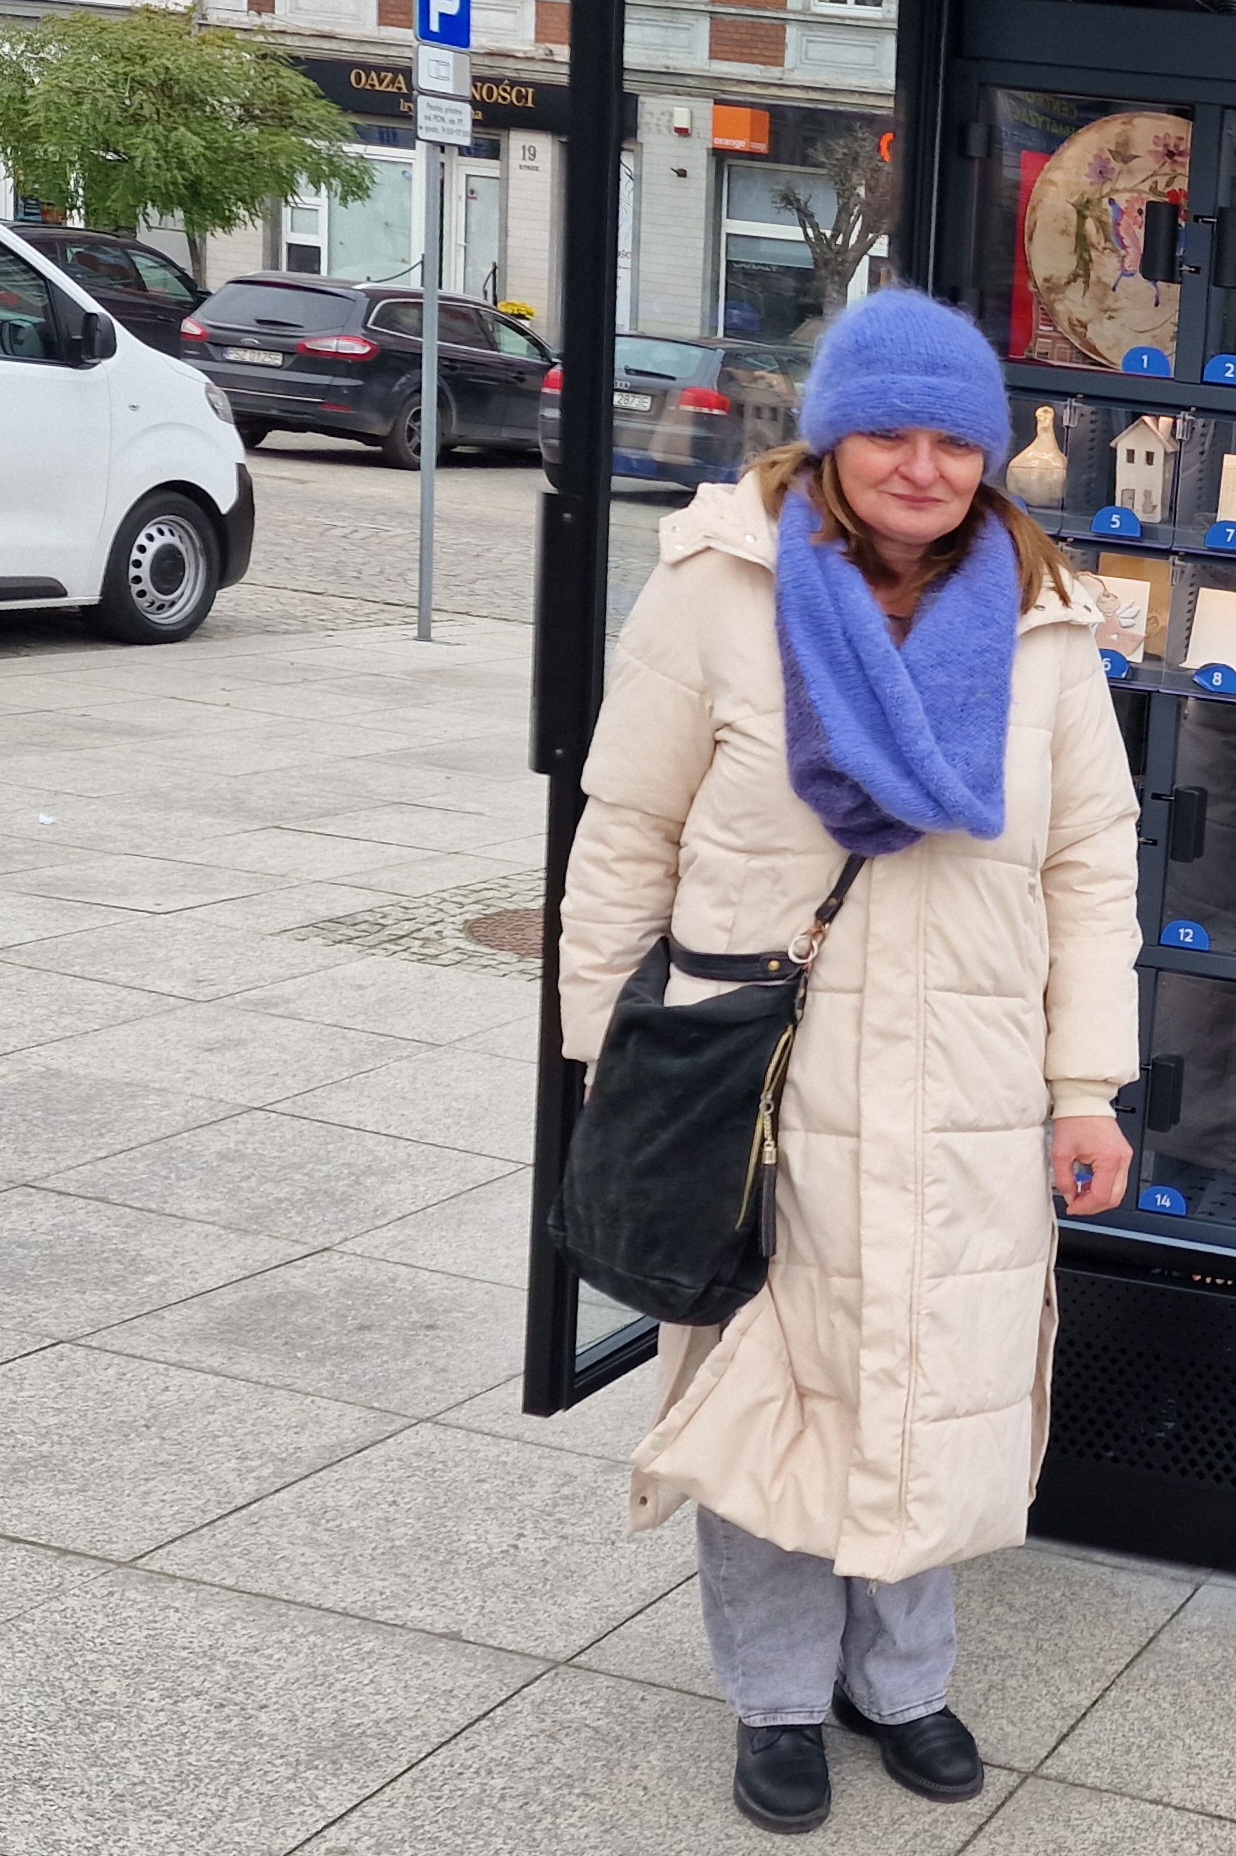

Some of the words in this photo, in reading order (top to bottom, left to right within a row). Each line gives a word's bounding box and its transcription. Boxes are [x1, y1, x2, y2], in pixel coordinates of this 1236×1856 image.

[429, 0, 460, 33] P
[350, 68, 408, 94] OAZA
[522, 144, 537, 161] 19
[1141, 354, 1148, 369] 1
[1224, 362, 1235, 378] 2
[1110, 514, 1121, 529] 5
[1225, 529, 1236, 543] 7
[1102, 658, 1112, 671] 6
[1212, 672, 1223, 686] 8
[1178, 927, 1194, 943] 12
[1155, 1193, 1171, 1208] 14
